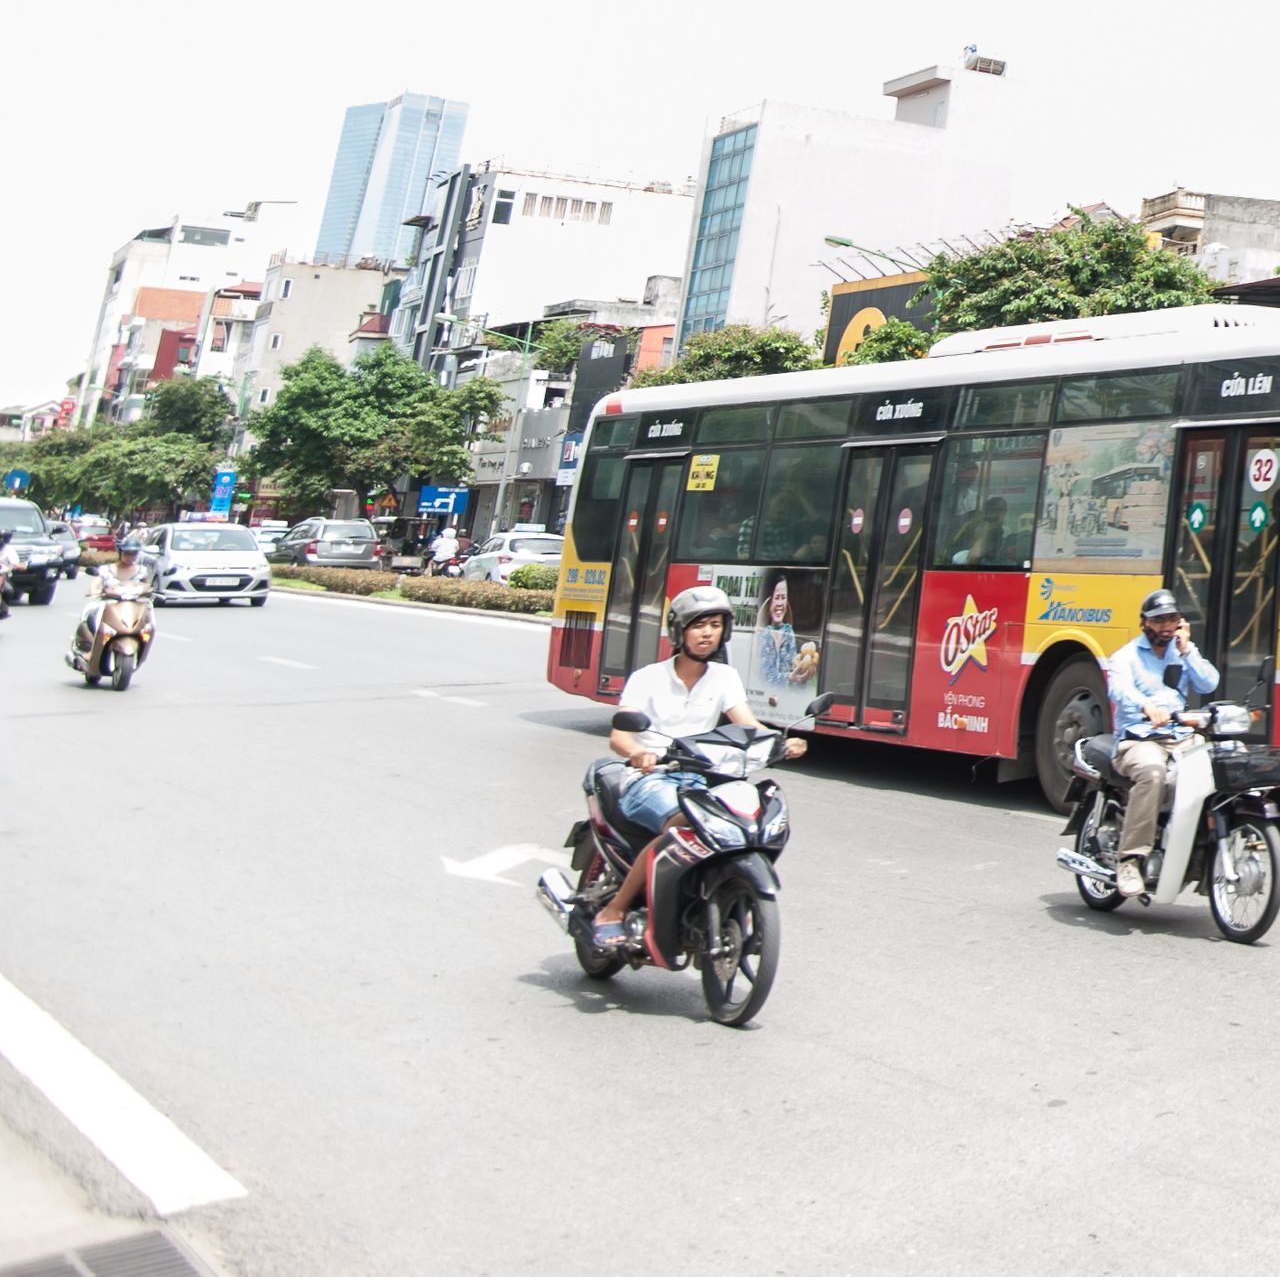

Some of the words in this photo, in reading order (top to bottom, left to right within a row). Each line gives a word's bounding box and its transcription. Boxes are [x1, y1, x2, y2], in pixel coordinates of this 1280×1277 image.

[1221, 372, 1246, 397] CỬA
[1247, 373, 1273, 395] LÊN
[1253, 458, 1274, 483] 32
[1038, 601, 1112, 623] HANOIBUS
[957, 693, 986, 708] PHONG
